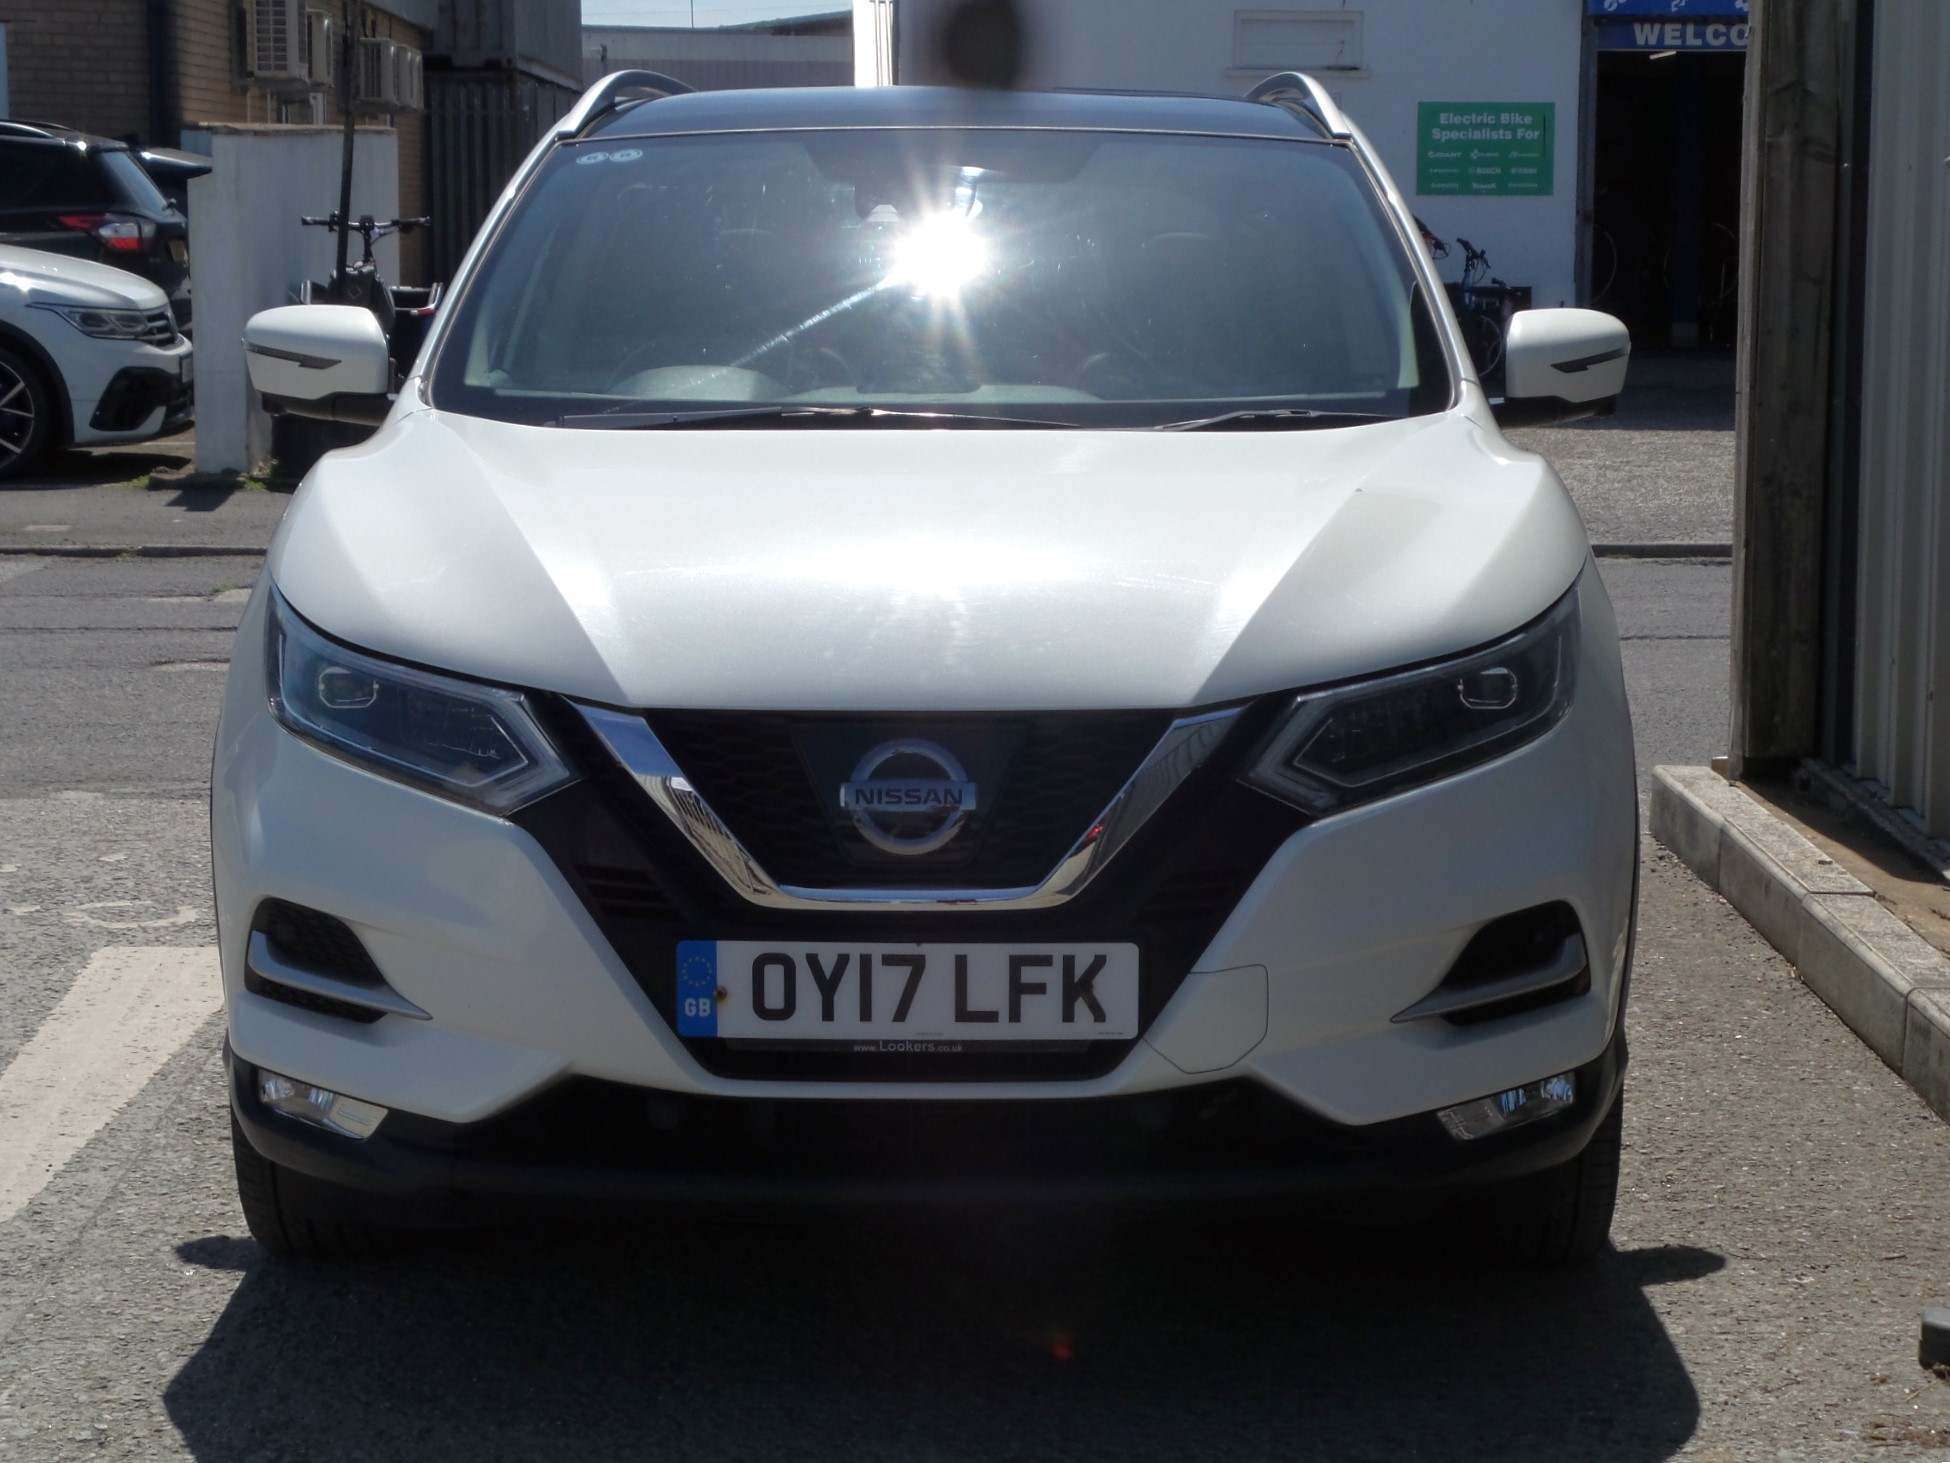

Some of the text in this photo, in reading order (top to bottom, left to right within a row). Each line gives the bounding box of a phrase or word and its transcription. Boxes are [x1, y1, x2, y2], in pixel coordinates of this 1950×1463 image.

[1439, 112, 1533, 125] Electric Bike
[1431, 127, 1541, 142] Specialists For
[855, 788, 963, 805] NISSAN
[751, 952, 1107, 1023] OY17 LFK
[684, 998, 711, 1017] GB
